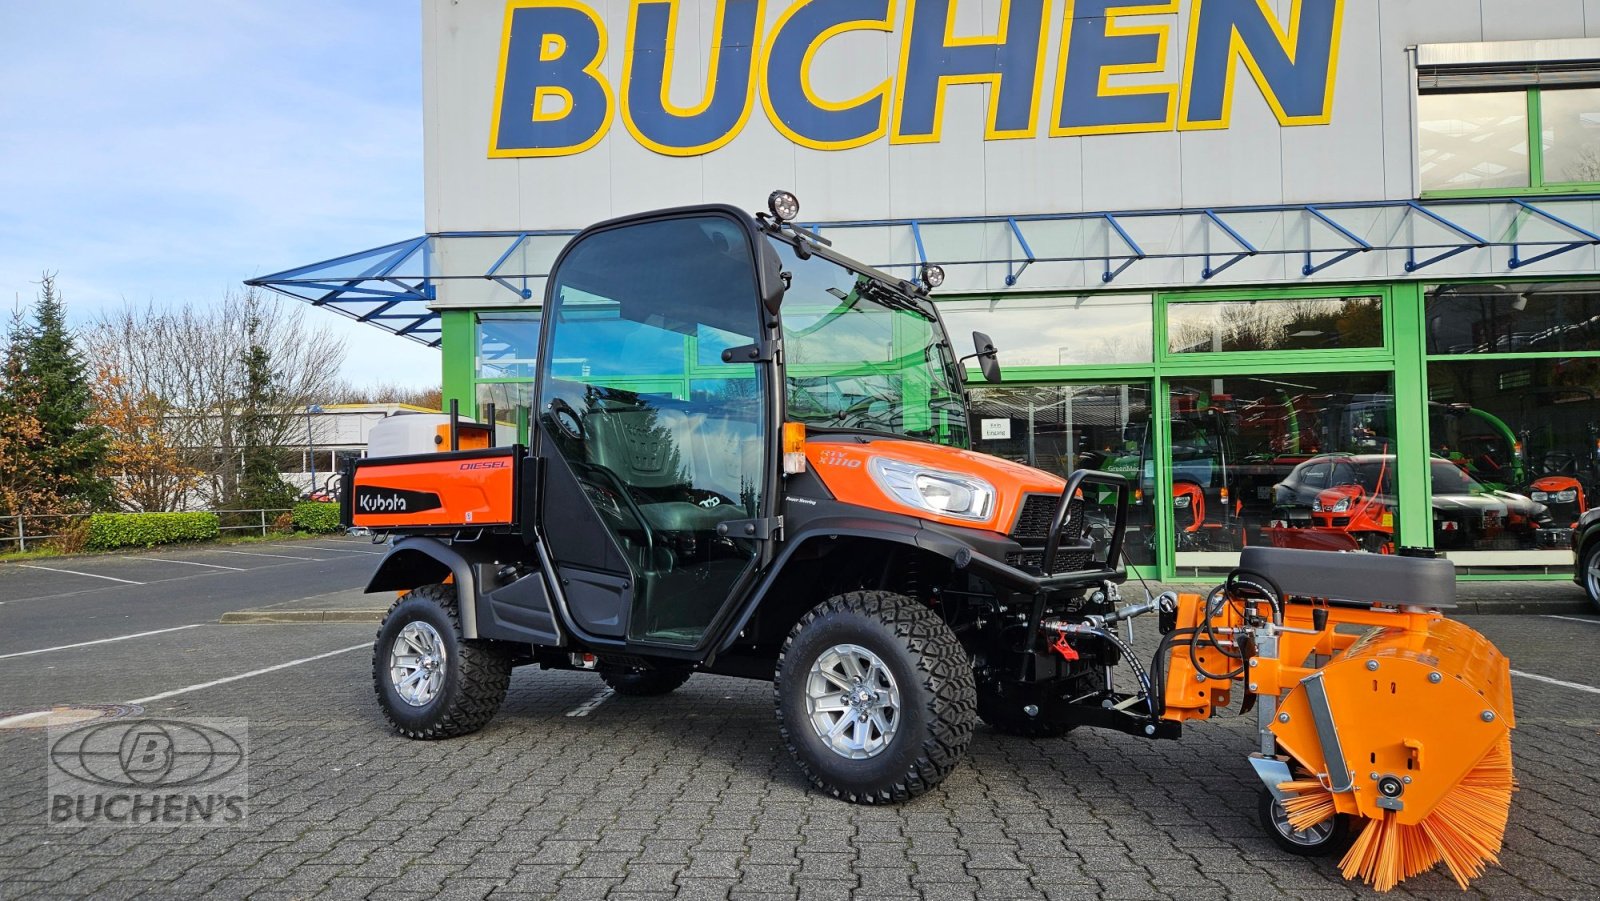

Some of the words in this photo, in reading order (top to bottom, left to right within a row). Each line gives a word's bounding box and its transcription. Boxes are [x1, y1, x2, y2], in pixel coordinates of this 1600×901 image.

[487, 0, 1345, 158] BUCHEN
[460, 461, 509, 470] DIESEL
[360, 494, 406, 511] Kubota
